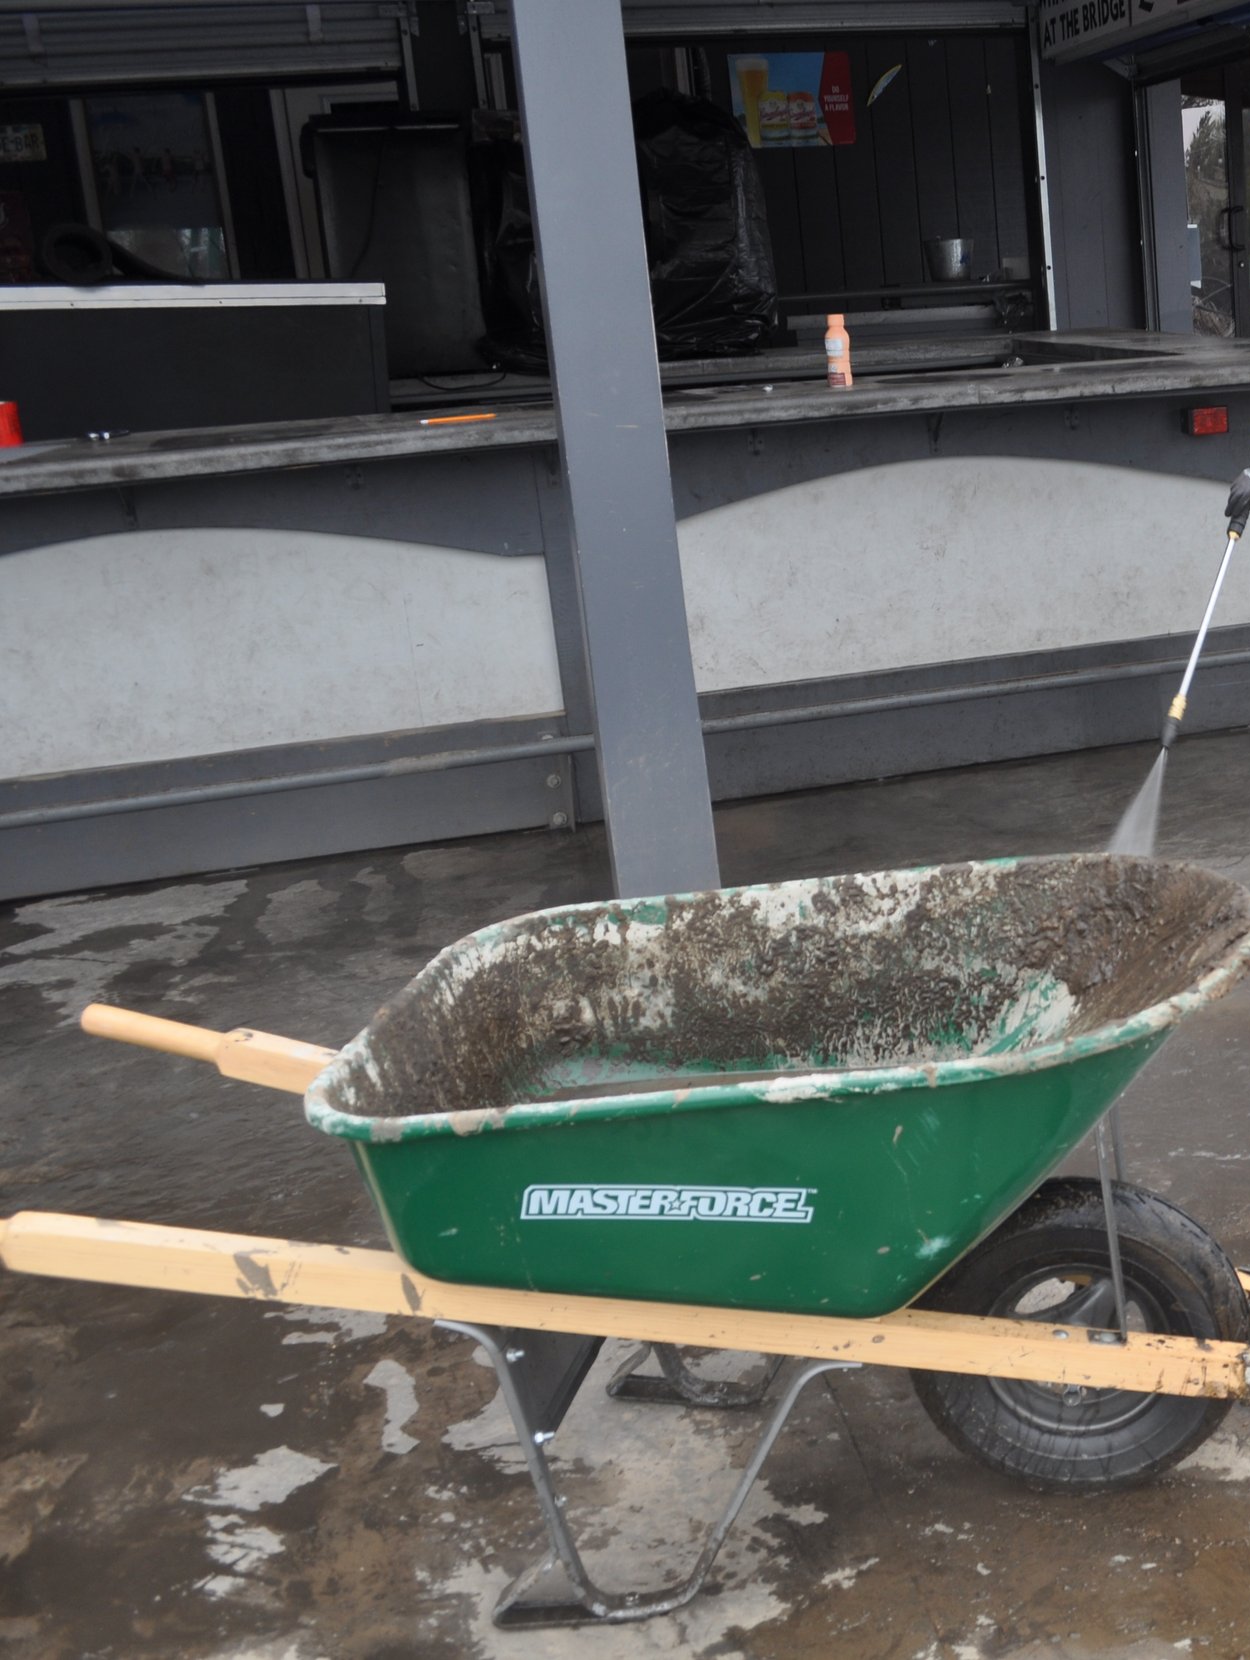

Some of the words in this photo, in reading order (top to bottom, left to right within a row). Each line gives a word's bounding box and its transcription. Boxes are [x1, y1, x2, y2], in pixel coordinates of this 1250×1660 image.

[1044, 17, 1056, 48] AT
[1060, 8, 1080, 41] THE
[1082, 0, 1126, 32] BRIDGE
[823, 94, 849, 103] YOURSELF
[829, 103, 849, 112] FLAVOR
[0, 134, 39, 152] E-BAR
[526, 1188, 806, 1218] MASTERFORCE
